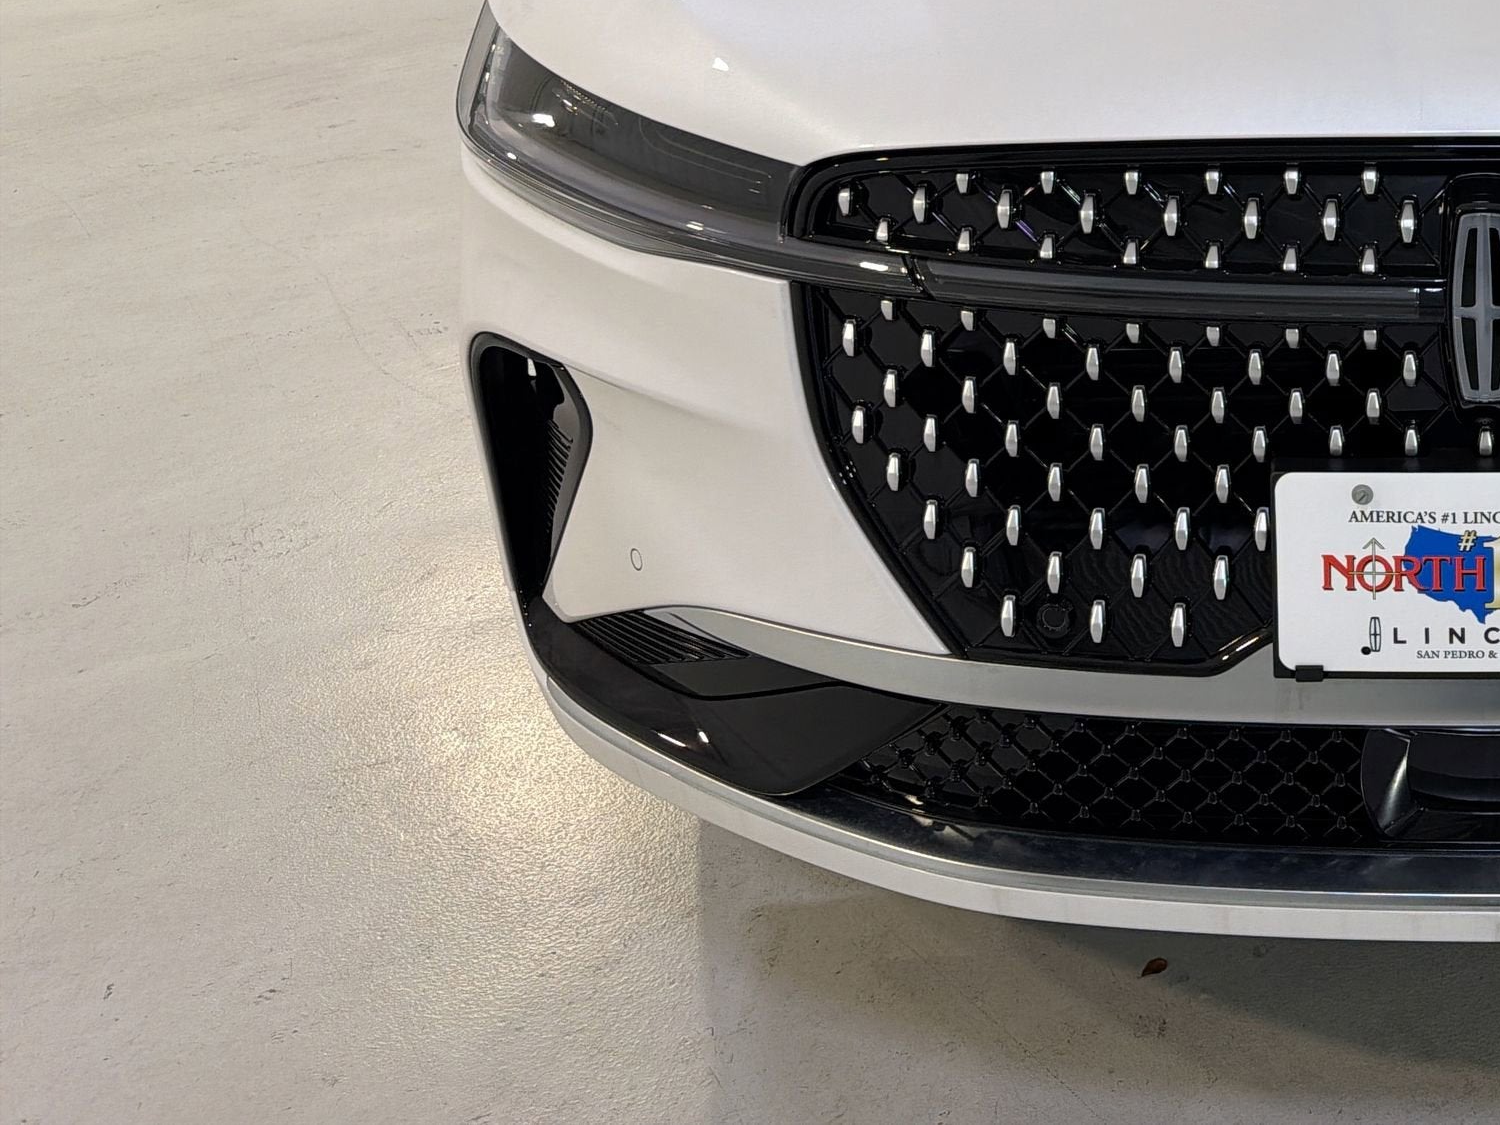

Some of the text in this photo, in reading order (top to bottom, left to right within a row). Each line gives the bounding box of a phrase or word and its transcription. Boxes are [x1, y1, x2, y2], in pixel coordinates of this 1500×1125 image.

[1348, 510, 1437, 525] AMERICA'S
[1440, 511, 1458, 525] #1
[1321, 554, 1487, 593] NORTH
[1416, 649, 1441, 660] SAN
[1443, 649, 1486, 660] PEDRO
[1488, 649, 1498, 660] &
